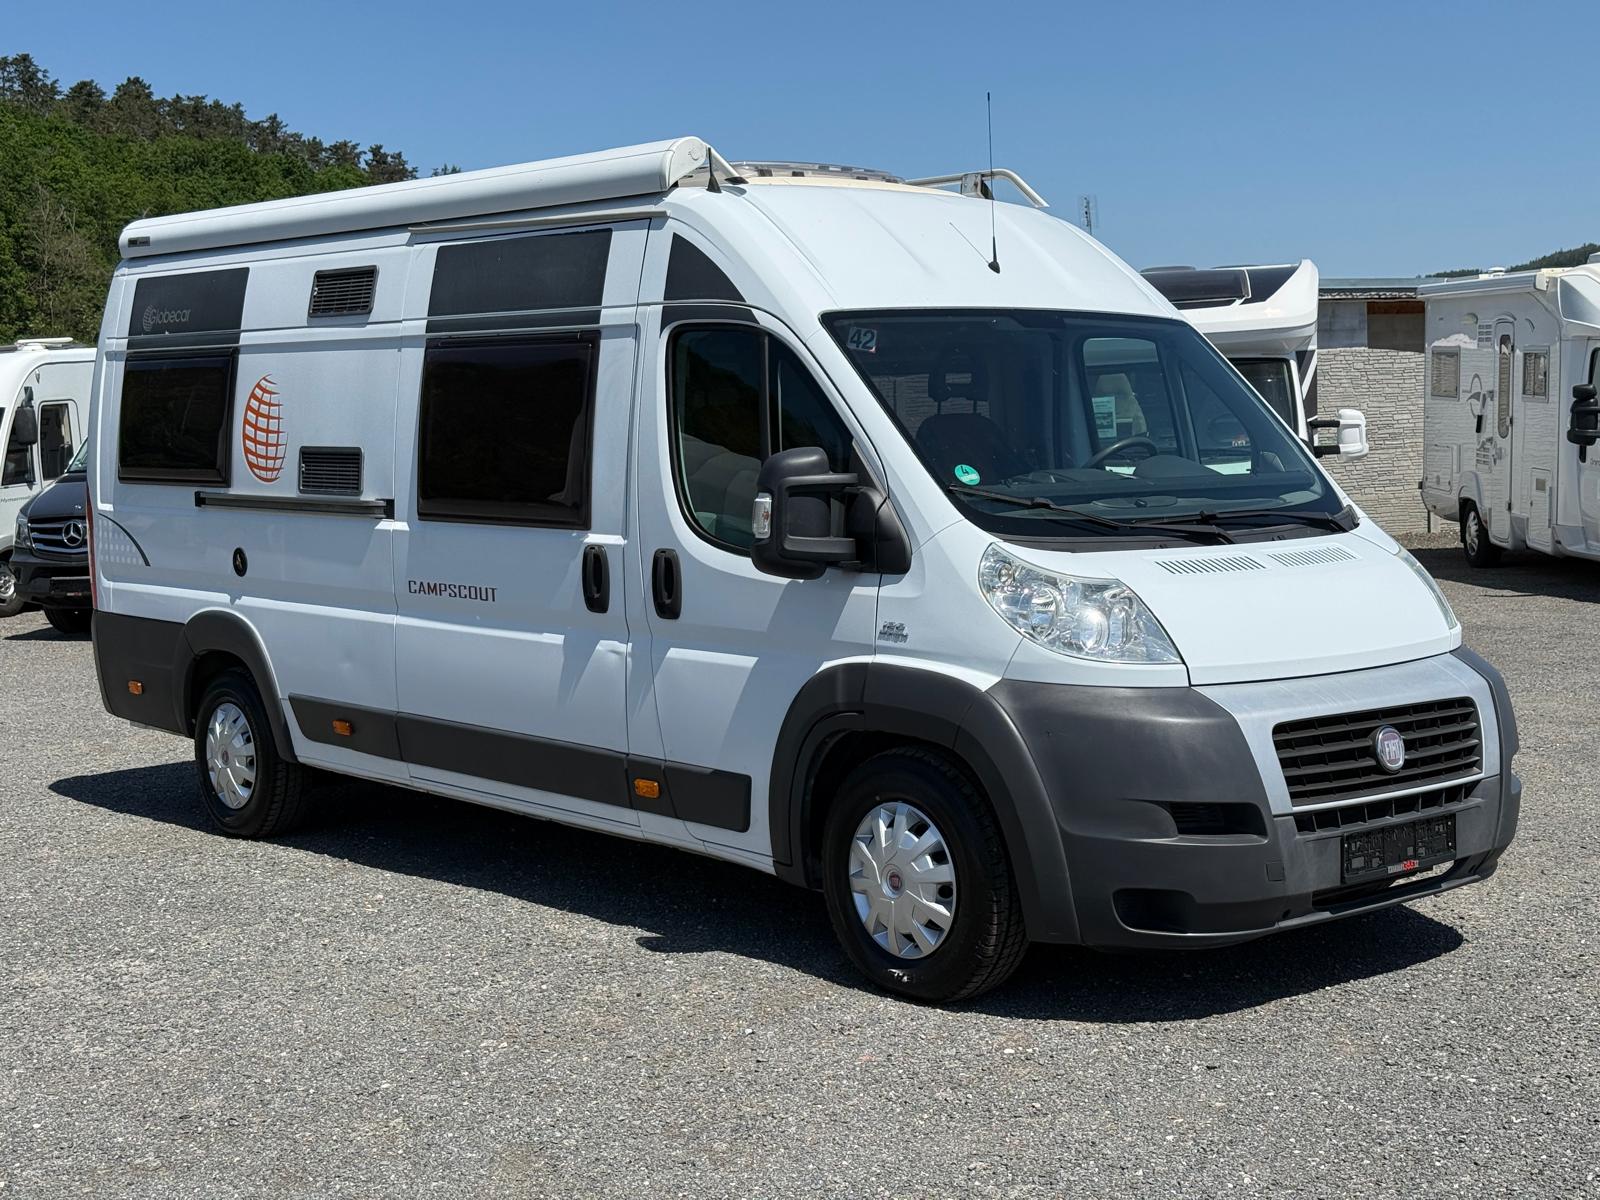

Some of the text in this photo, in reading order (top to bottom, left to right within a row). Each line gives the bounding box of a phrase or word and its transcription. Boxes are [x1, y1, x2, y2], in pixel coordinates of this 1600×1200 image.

[150, 308, 192, 325] Globecar
[850, 328, 875, 349] 42
[408, 580, 498, 602] CAMPSCOUT
[1384, 740, 1402, 760] FIAT
